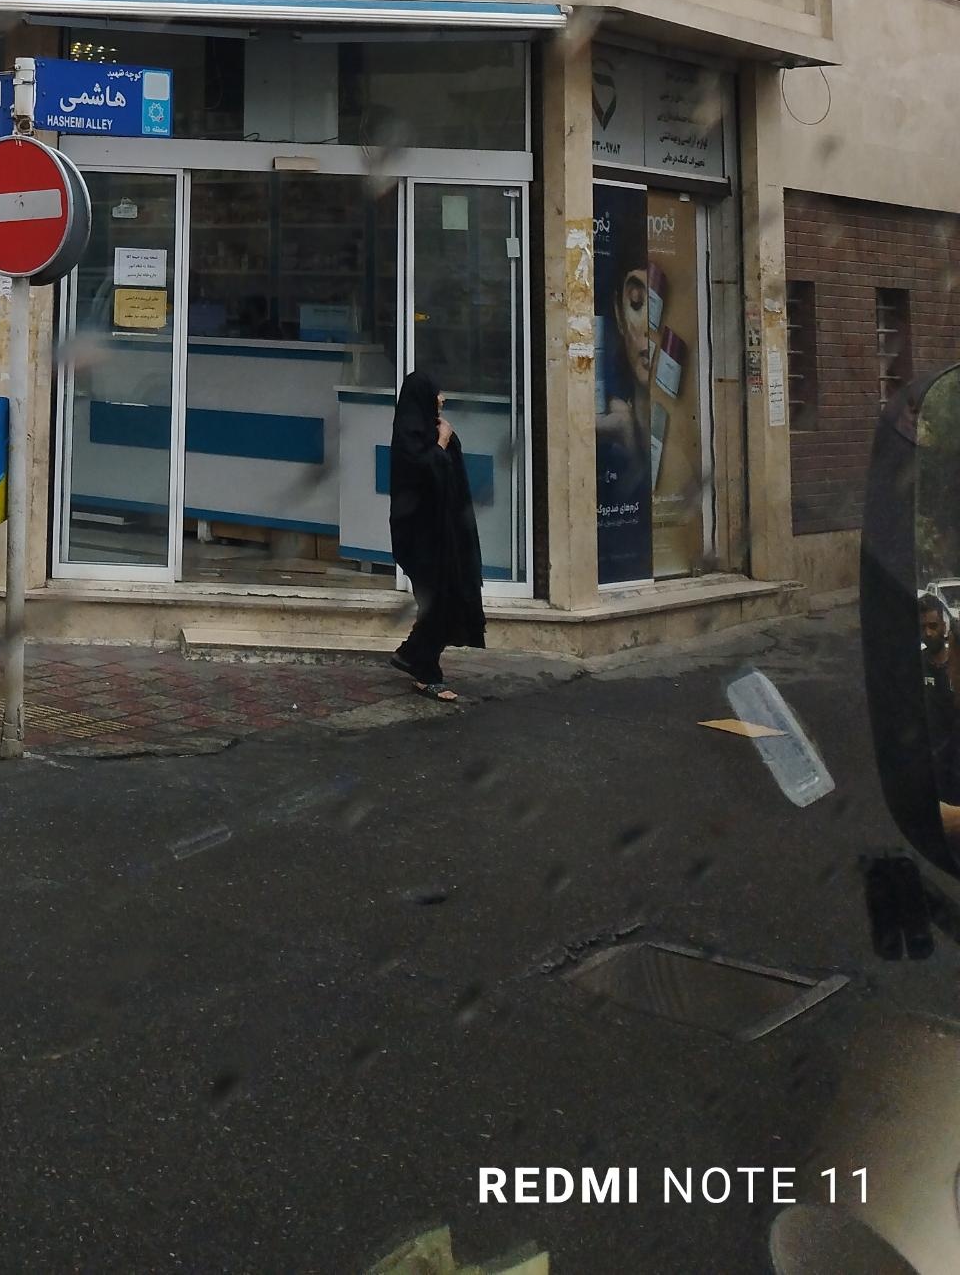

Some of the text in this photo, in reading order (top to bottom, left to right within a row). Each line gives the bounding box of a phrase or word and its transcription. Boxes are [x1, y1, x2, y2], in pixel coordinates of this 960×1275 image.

[107, 69, 143, 82] کوچه شهید
[60, 83, 127, 113] هاشمی
[47, 114, 113, 130] HASHEMI ALLEY
